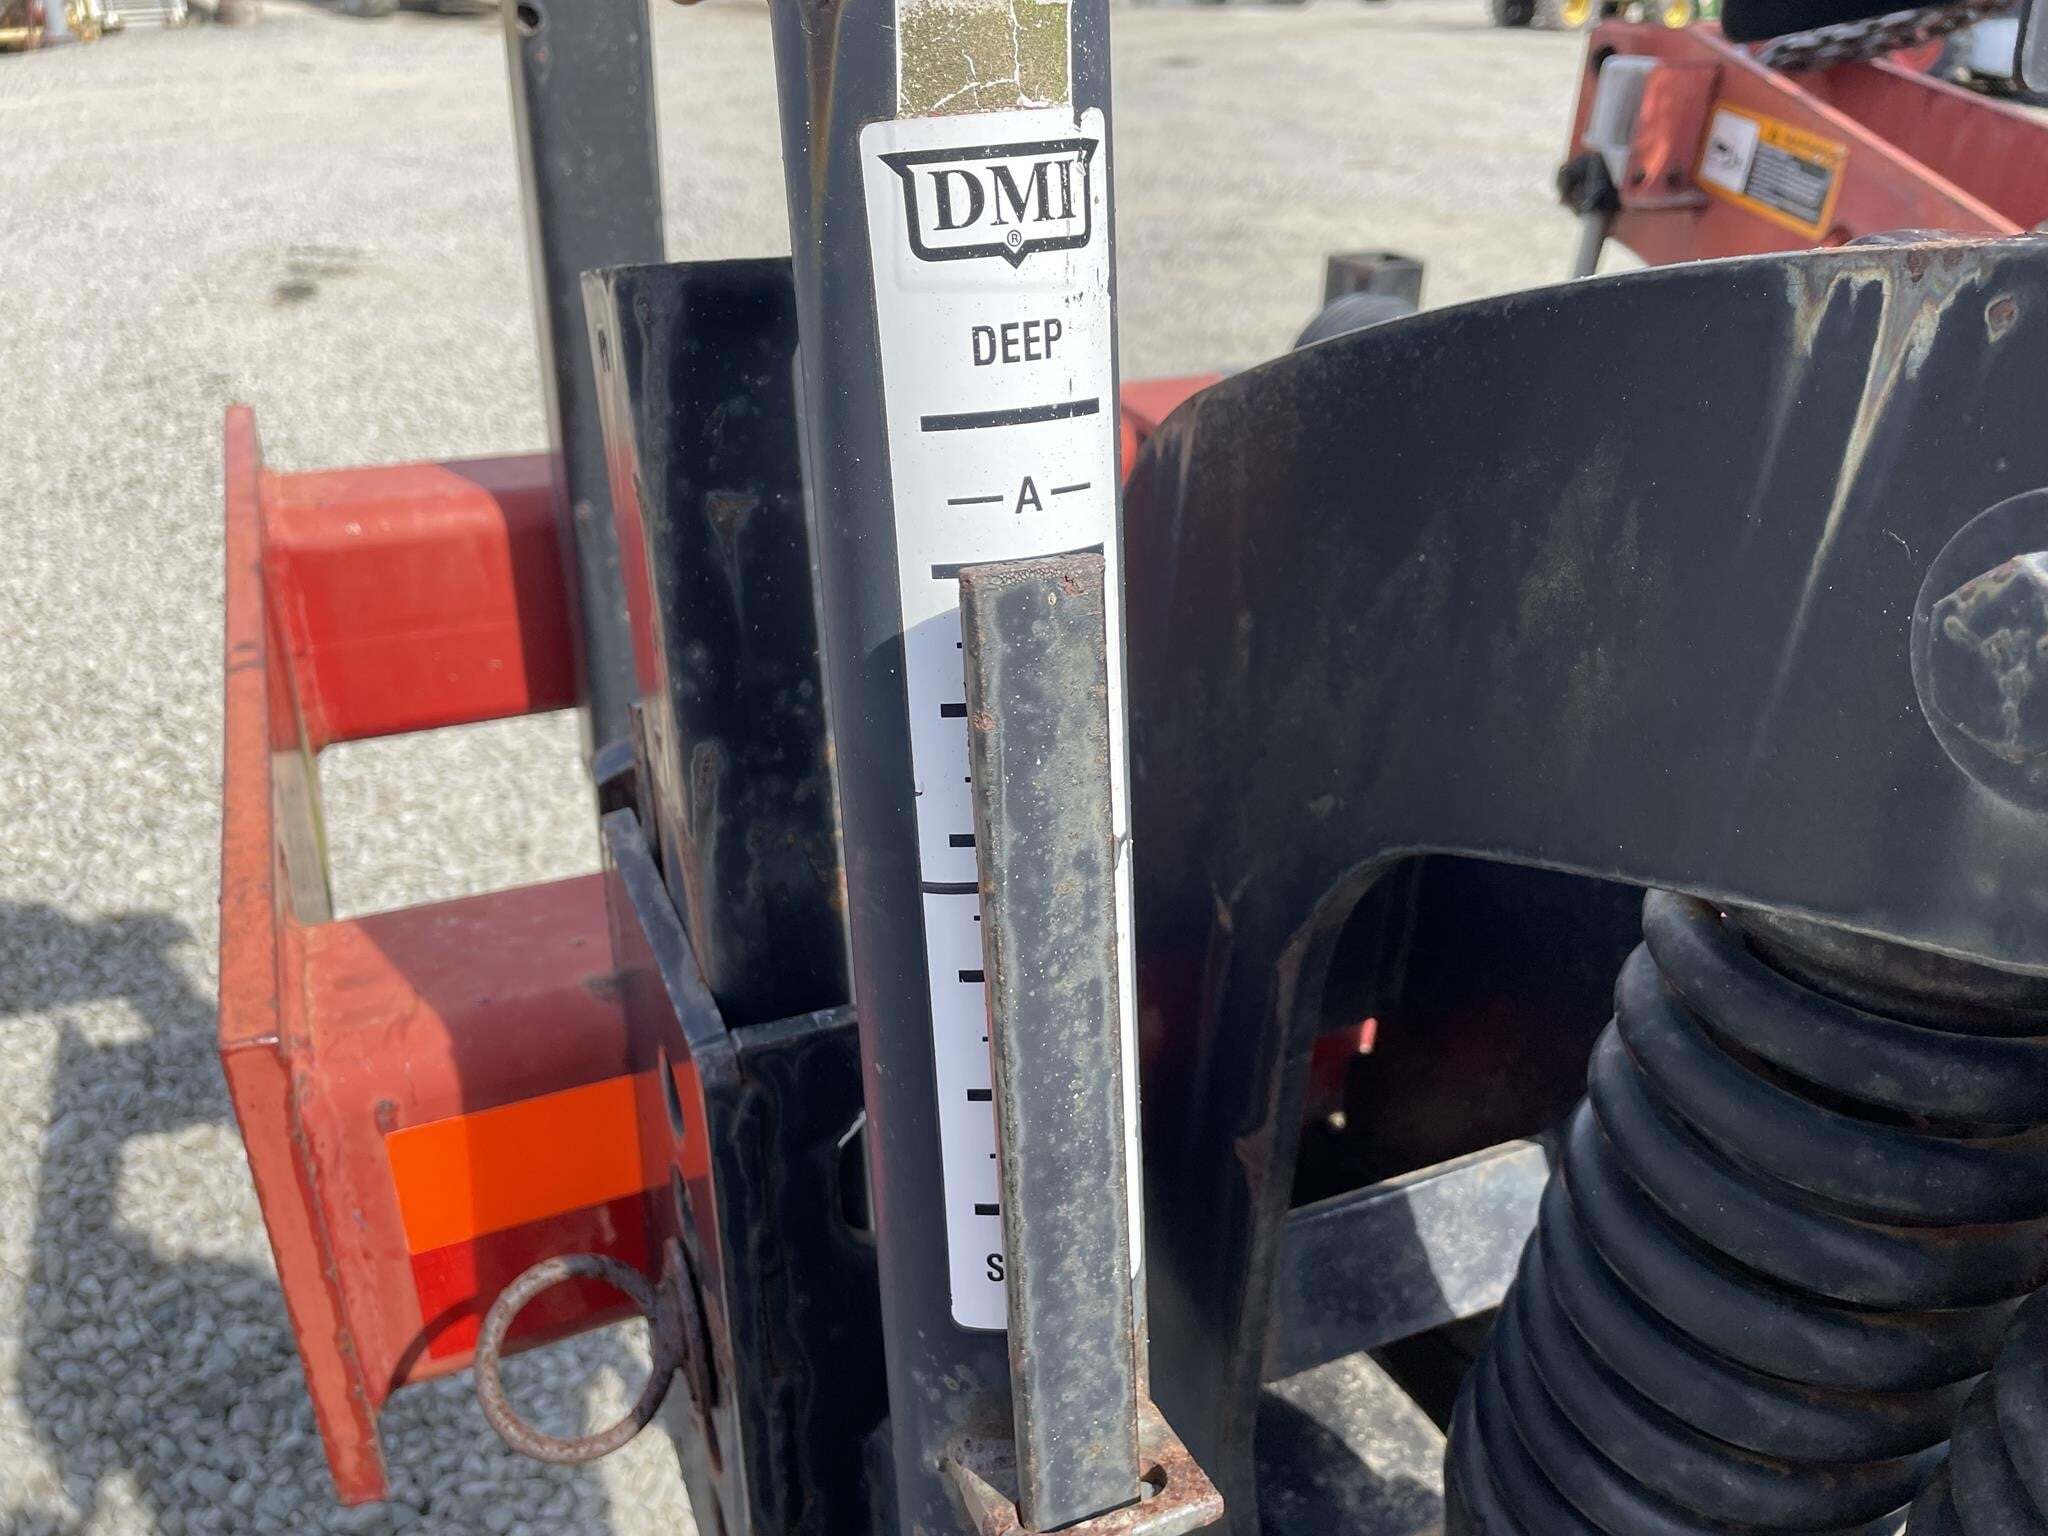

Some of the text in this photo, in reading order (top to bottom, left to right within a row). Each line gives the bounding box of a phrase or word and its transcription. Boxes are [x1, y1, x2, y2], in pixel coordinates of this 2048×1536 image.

[927, 158, 1077, 231] DMI
[971, 317, 1063, 366] DEEP
[1015, 475, 1044, 515] A
